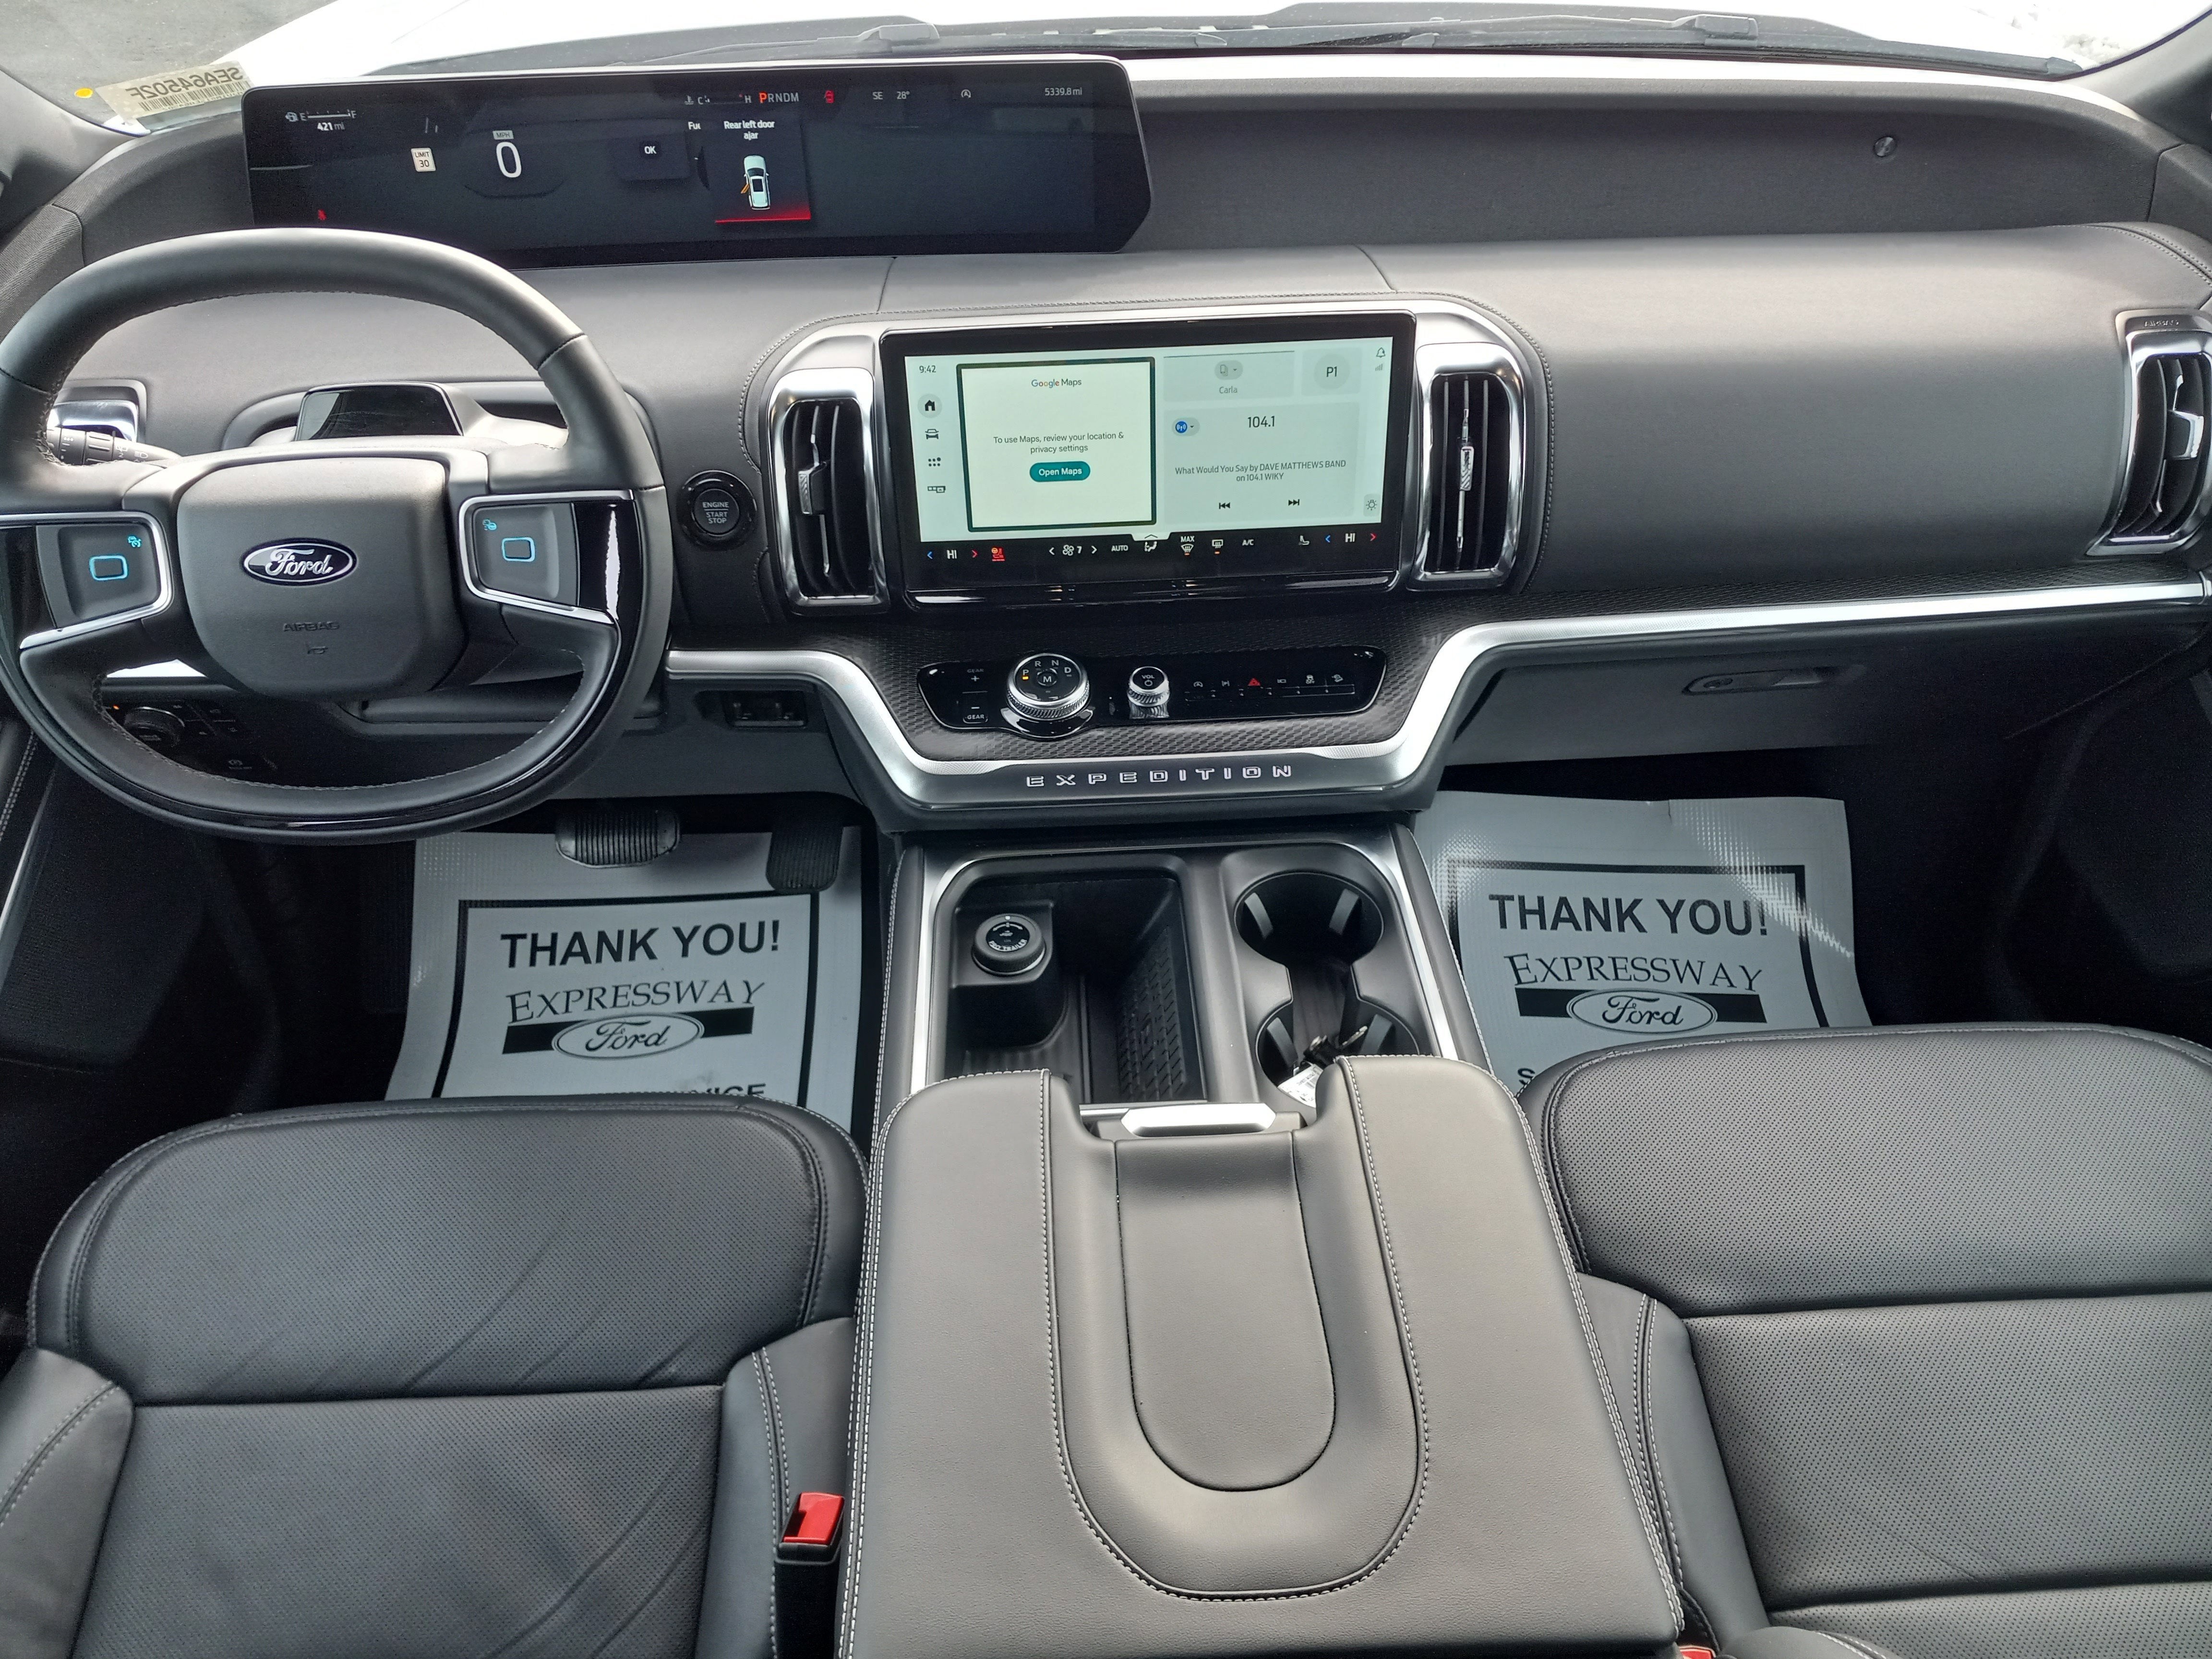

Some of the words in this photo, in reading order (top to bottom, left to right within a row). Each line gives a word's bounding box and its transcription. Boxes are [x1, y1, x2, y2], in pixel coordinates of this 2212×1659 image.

[872, 91, 883, 99] SE
[1045, 87, 1071, 96] 5339.8
[317, 122, 333, 131] 421
[724, 120, 741, 129] Rear
[757, 120, 775, 128] door
[744, 132, 758, 141] ajar
[496, 142, 522, 178] 0
[1326, 366, 1337, 377] P1
[1032, 379, 1059, 388] Google
[1061, 379, 1082, 387] Maps
[1219, 386, 1238, 394] Carla
[1248, 416, 1275, 428] 104.1
[1020, 436, 1041, 444] Maps,
[1031, 445, 1057, 454] privacy
[1059, 445, 1088, 453] settings
[1038, 469, 1059, 477] Open
[1061, 468, 1082, 476] Maps
[1196, 466, 1219, 474] Would
[1235, 465, 1249, 473] Say
[1250, 464, 1258, 472] by
[1281, 461, 1323, 470] MATTHEWS
[1325, 460, 1346, 468] BAND
[1345, 533, 1355, 542] HI
[947, 550, 957, 559] HI
[265, 549, 334, 576] Ford
[282, 621, 340, 632] AIRBAG
[1026, 765, 1291, 787] EXPEDITION
[1489, 894, 1647, 933] THANK
[1656, 898, 1767, 936] YOU!
[500, 927, 659, 969] THANK
[672, 919, 780, 958] YOU!
[989, 940, 1000, 950] PRO
[1003, 938, 1027, 951] TRAILER
[1503, 952, 1763, 992] EXPRESSWAY
[505, 979, 765, 1024] EXPRESSWAY
[1601, 995, 1683, 1025] Ford
[585, 1020, 671, 1052] Ford
